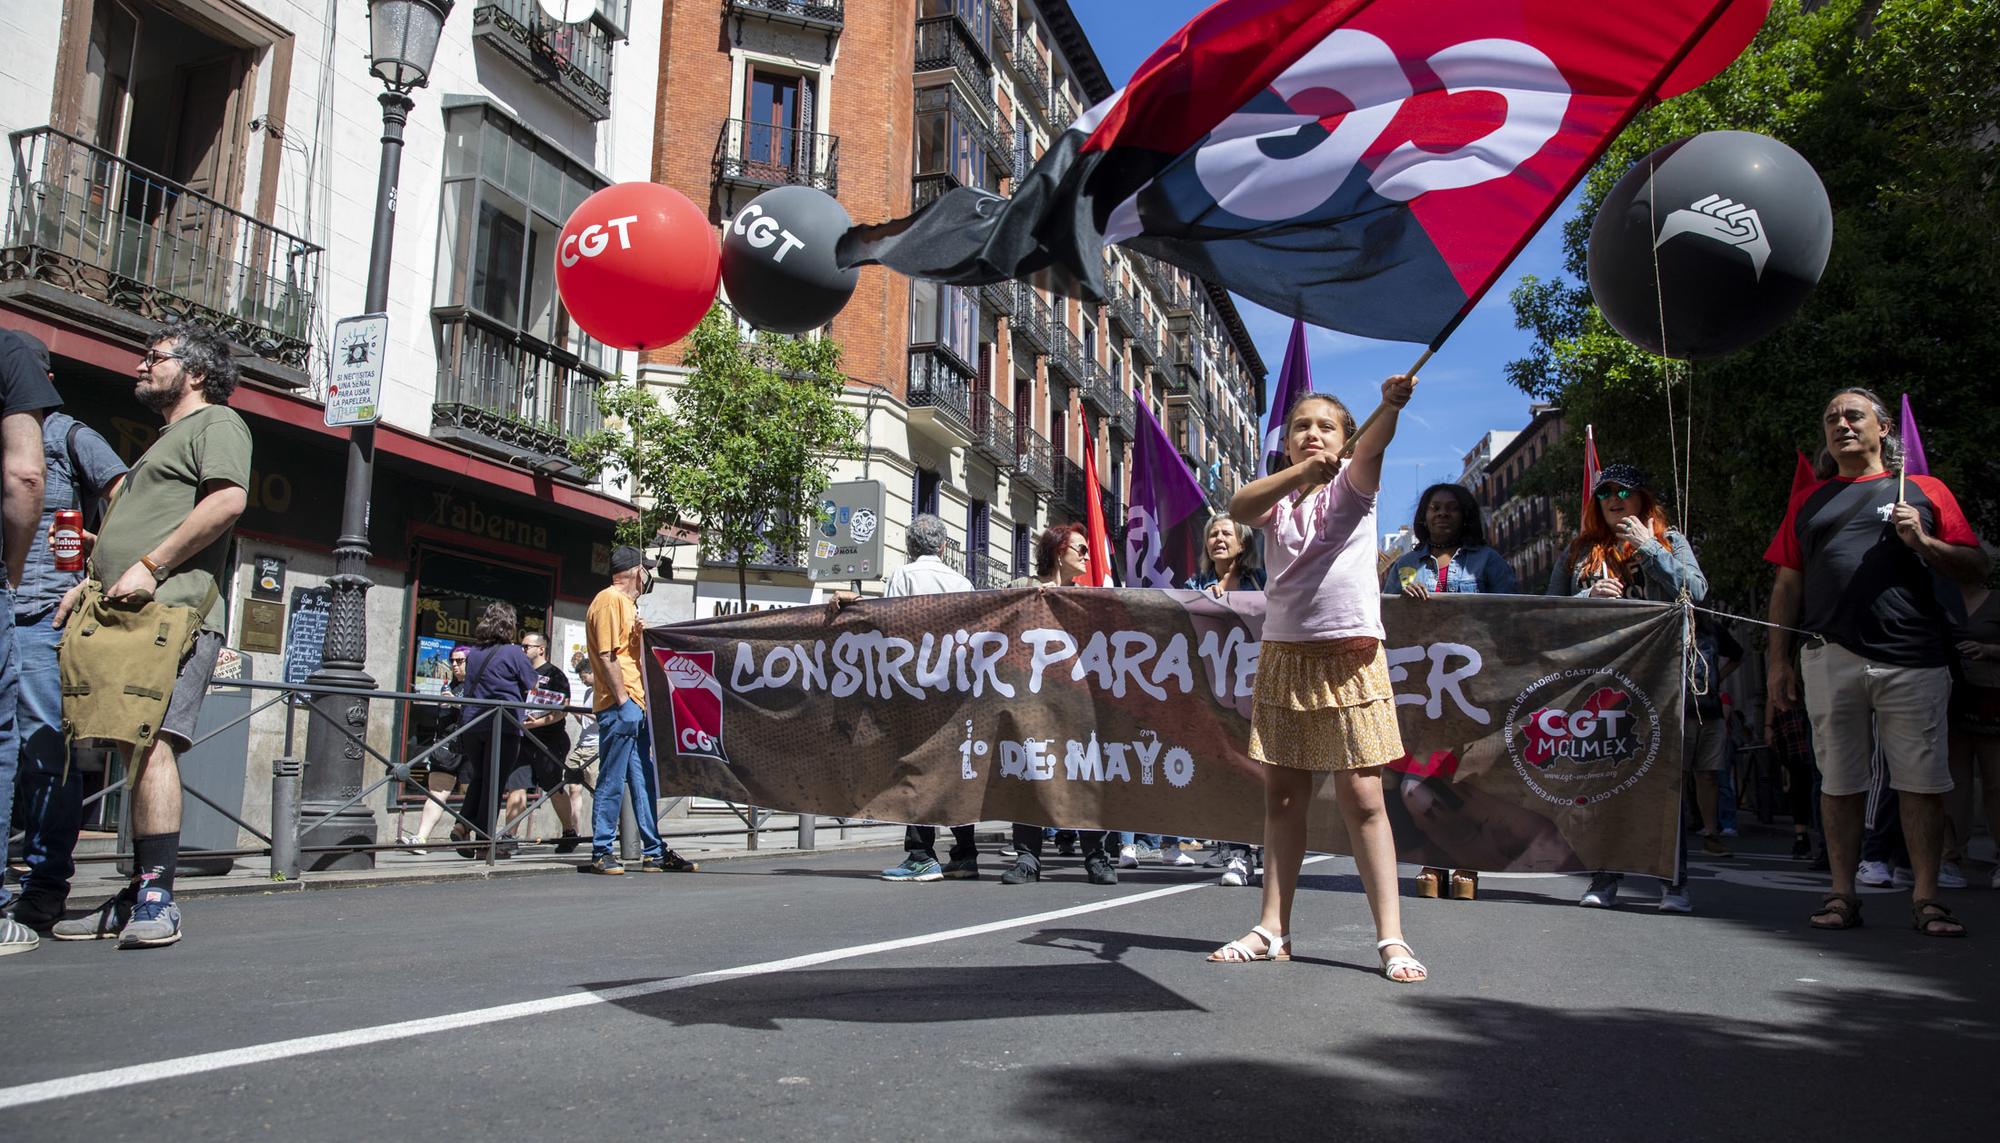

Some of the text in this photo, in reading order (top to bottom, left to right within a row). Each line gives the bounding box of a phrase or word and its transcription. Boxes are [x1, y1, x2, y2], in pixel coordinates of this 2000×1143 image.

[560, 215, 639, 268] CGT
[733, 204, 806, 263] CGT
[338, 382, 351, 390] UNA
[338, 388, 370, 398] PARA USAR
[333, 399, 340, 407] LA
[432, 491, 547, 549] Taberna
[301, 593, 312, 605] San
[435, 610, 470, 636] San
[1021, 628, 1193, 700] PARA
[1198, 626, 1491, 725] VEER
[1565, 667, 1613, 678] CASTILLA
[1516, 690, 1528, 705] DE
[1504, 704, 1521, 753] TERRITORIAL
[1538, 709, 1626, 738] CGT
[682, 727, 720, 756] CGT
[1537, 737, 1628, 758] MCLMEX
[1638, 713, 1661, 777] EXTREMADURA
[1000, 736, 1056, 781] DE
[1065, 729, 1195, 789] MAYO
[1613, 783, 1625, 795] LA
[1624, 776, 1639, 788] DE
[1590, 792, 1612, 804] CGT
